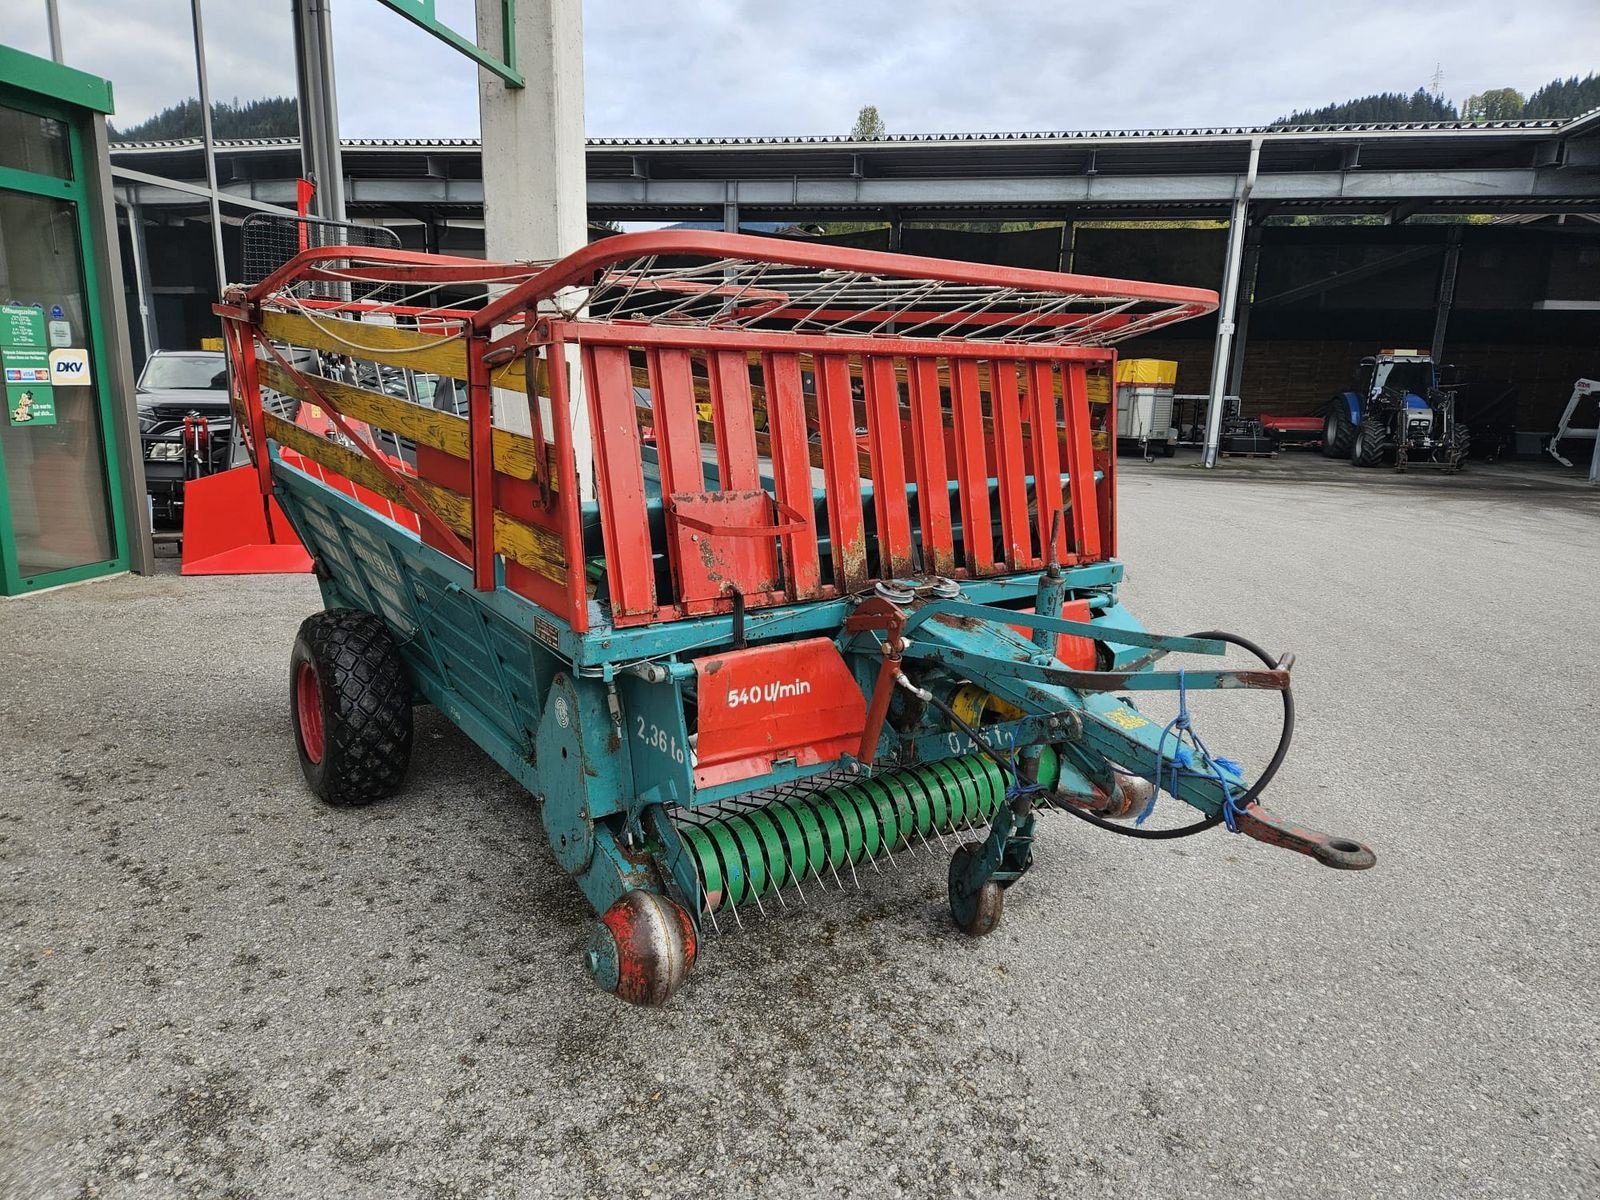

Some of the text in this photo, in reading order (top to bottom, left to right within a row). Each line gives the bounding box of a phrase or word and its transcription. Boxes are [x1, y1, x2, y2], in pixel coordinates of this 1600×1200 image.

[56, 362, 82, 372] DKV
[728, 678, 811, 708] 540 U/min
[637, 715, 667, 752] 2,36
